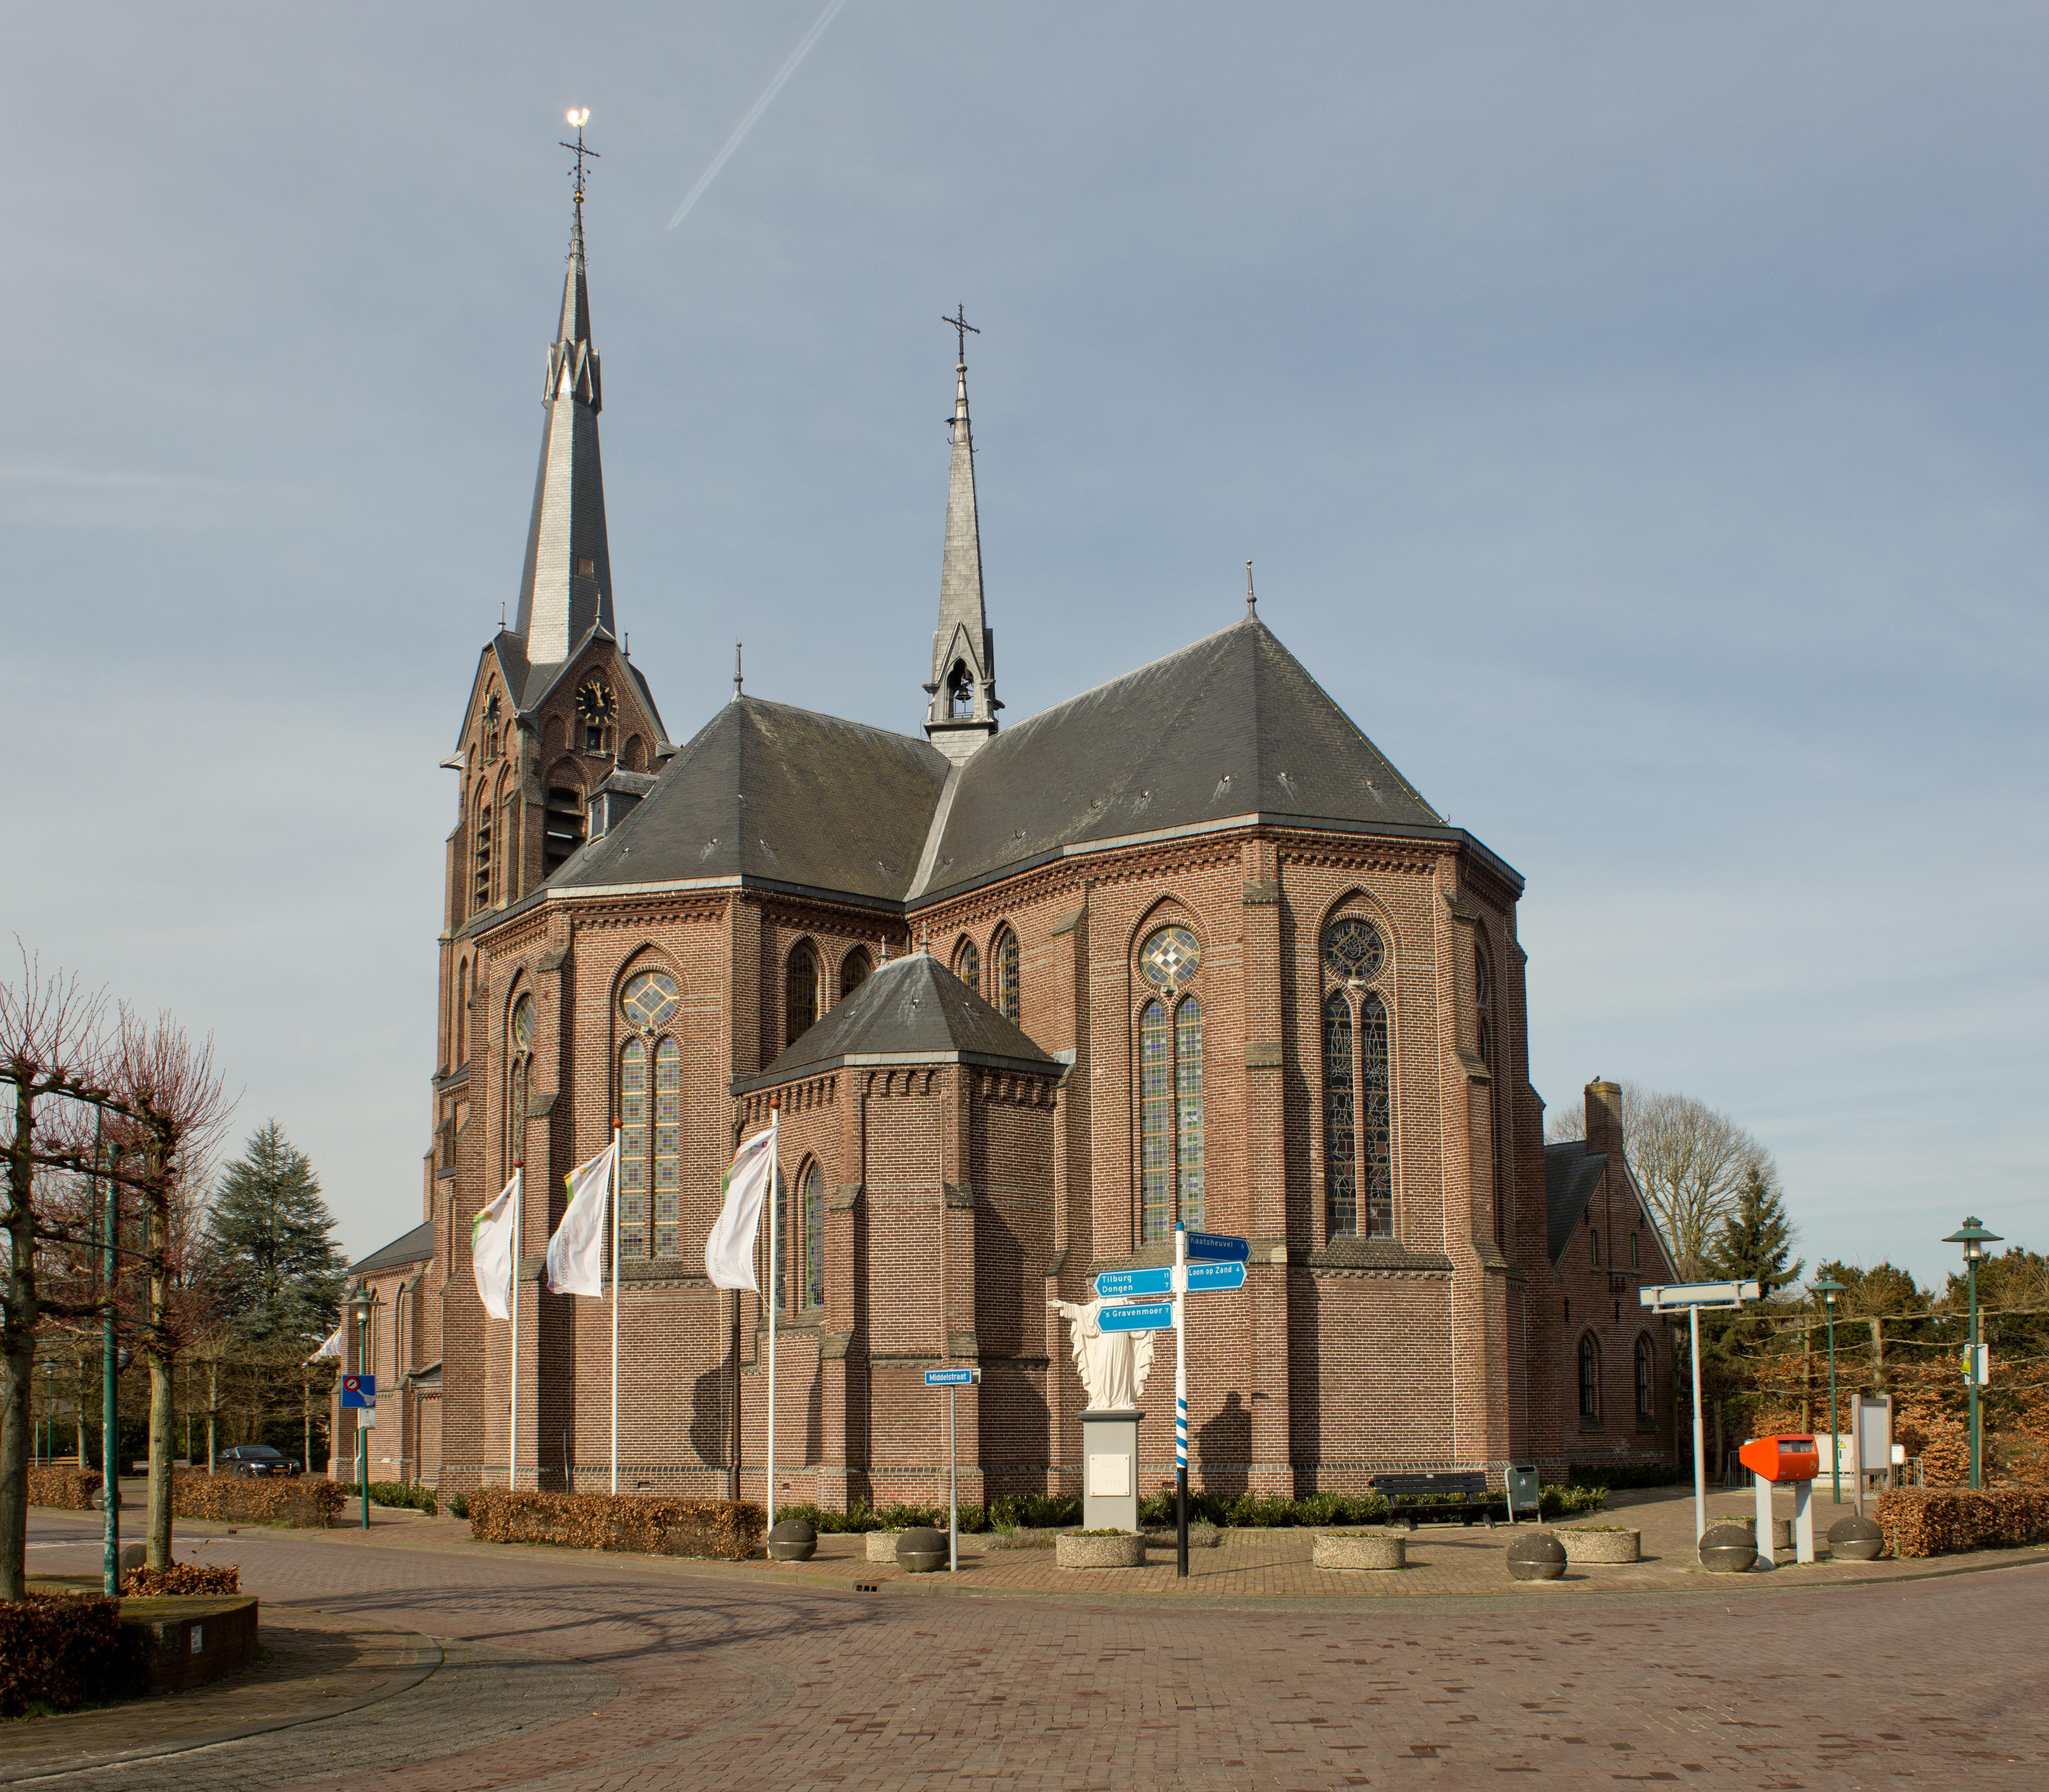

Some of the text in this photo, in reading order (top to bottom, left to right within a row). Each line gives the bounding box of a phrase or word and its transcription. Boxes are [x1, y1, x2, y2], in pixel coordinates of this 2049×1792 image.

[1190, 1237, 1233, 1247] Kaatsheuvel
[1215, 1266, 1232, 1274] Zand
[1112, 1308, 1162, 1317] Gravenmoer
[929, 1372, 967, 1381] Middelstraat
